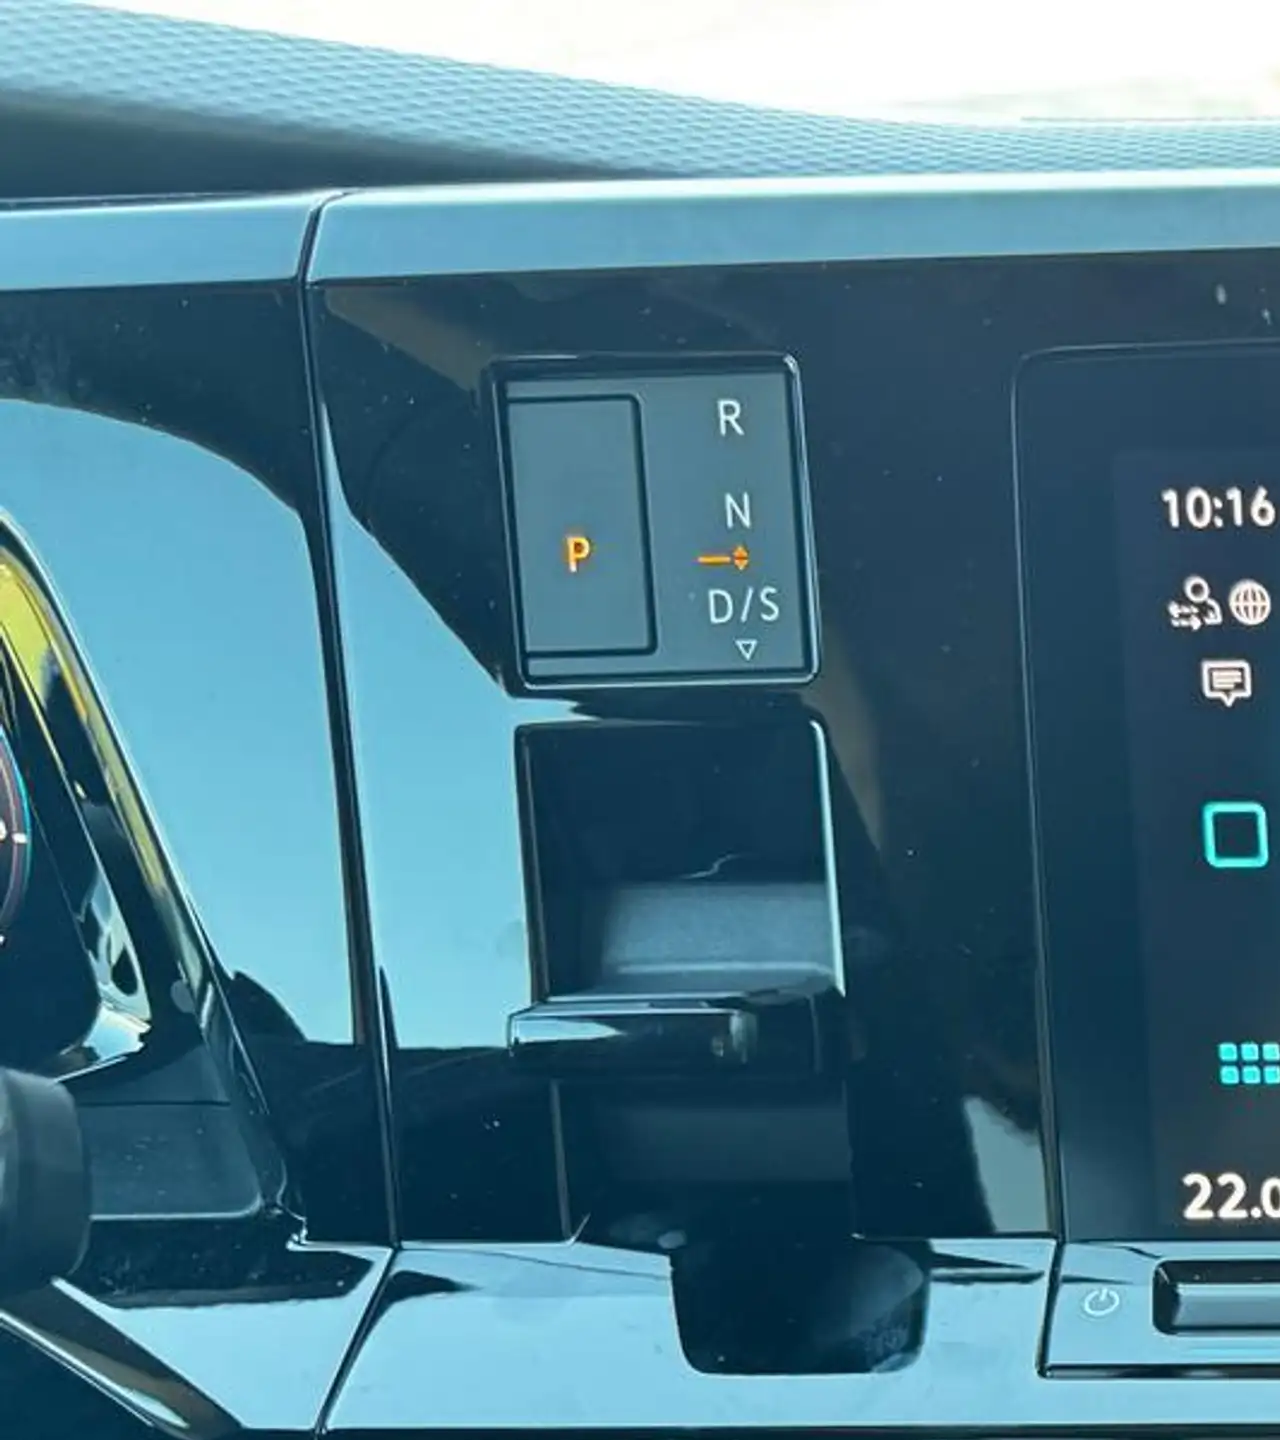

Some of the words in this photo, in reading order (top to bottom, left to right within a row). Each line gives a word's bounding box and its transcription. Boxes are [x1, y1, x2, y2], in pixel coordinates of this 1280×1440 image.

[717, 399, 744, 436] R
[725, 492, 751, 529] N
[1162, 486, 1276, 529] 10:16
[567, 536, 590, 573] P
[708, 586, 780, 624] D/S
